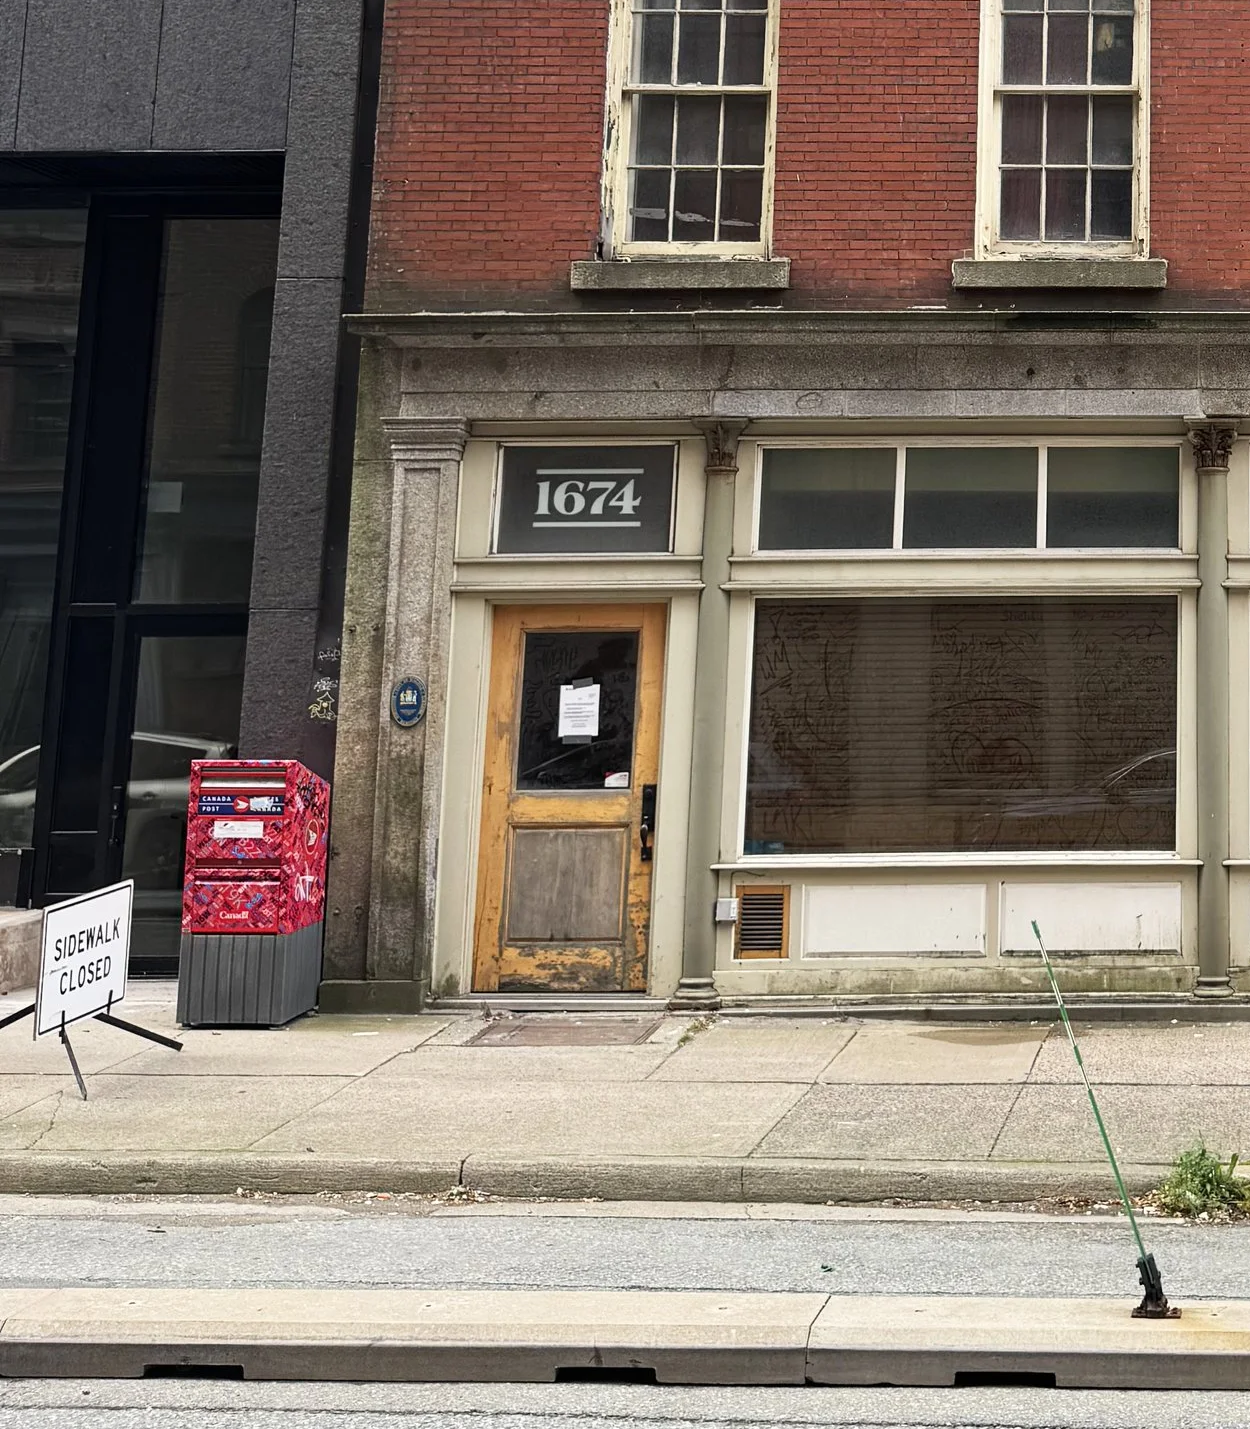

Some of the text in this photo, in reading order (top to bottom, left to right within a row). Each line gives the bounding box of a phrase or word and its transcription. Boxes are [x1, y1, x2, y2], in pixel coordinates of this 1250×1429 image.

[534, 478, 642, 516] 1674
[54, 917, 121, 962] SIDEWALK
[59, 955, 112, 995] CLOSED
